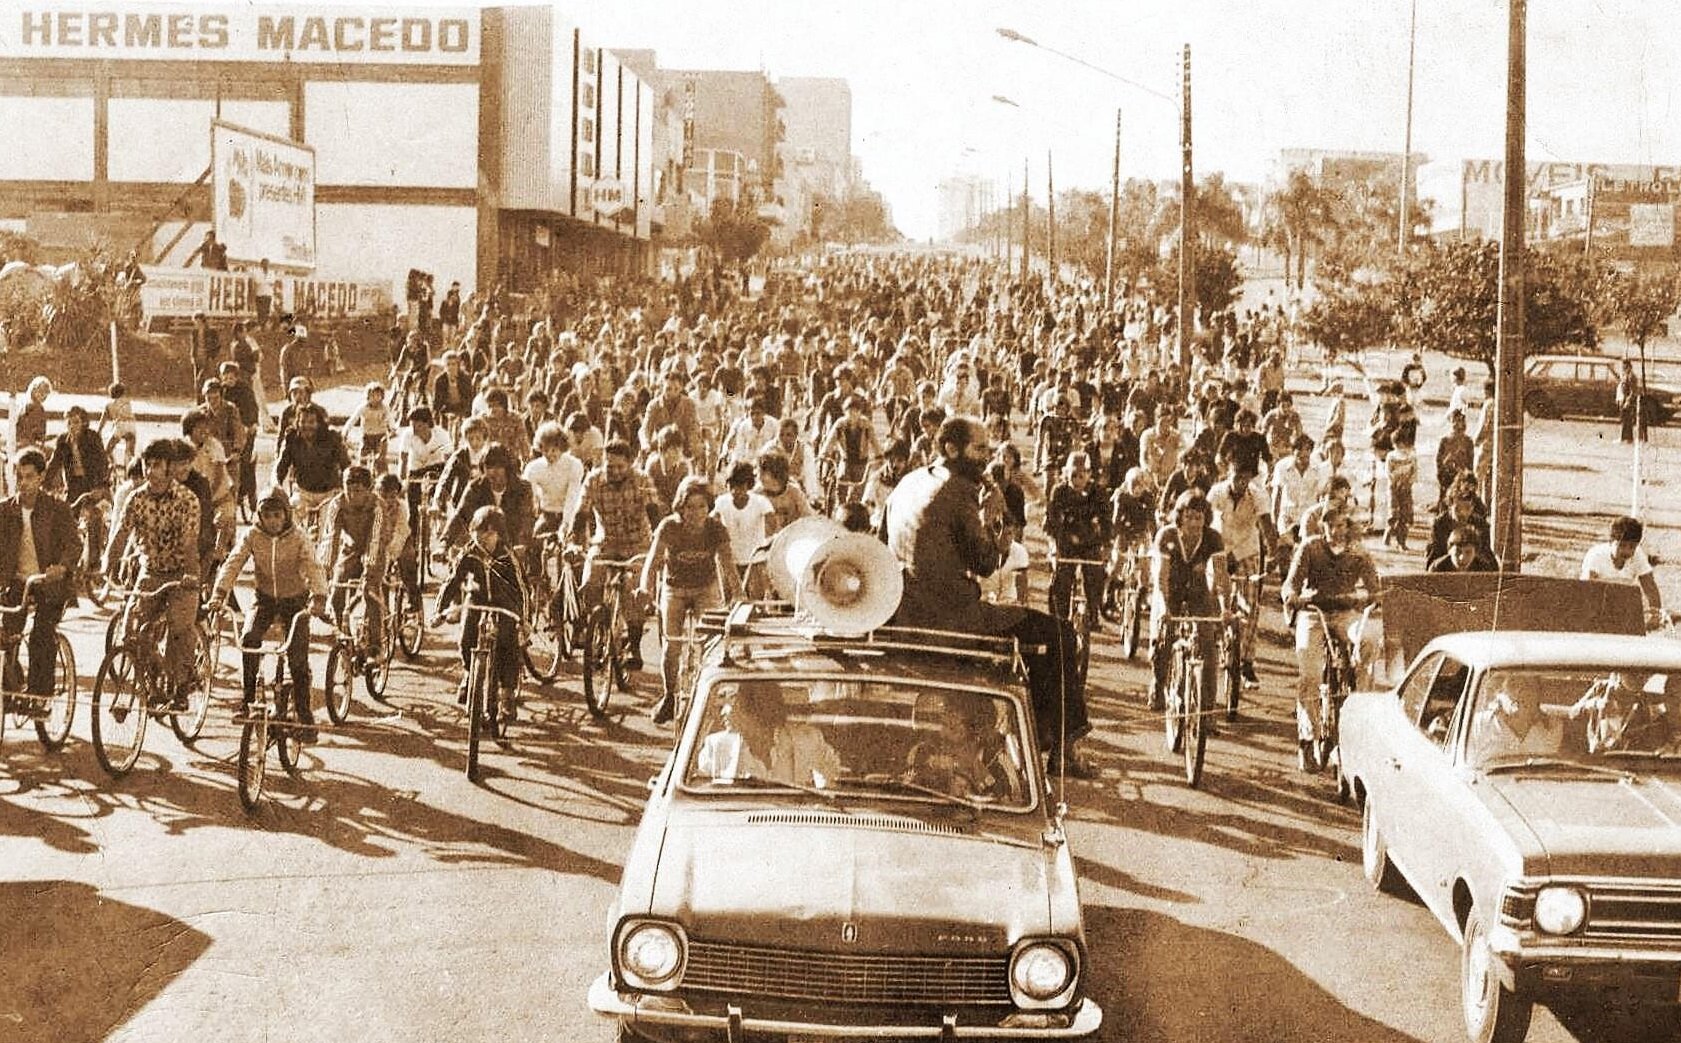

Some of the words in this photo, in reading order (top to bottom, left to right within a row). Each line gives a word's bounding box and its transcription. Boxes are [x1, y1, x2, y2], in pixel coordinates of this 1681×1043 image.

[22, 12, 229, 48] HERMES
[257, 16, 469, 52] MACEDO
[294, 279, 357, 314] MACEDO
